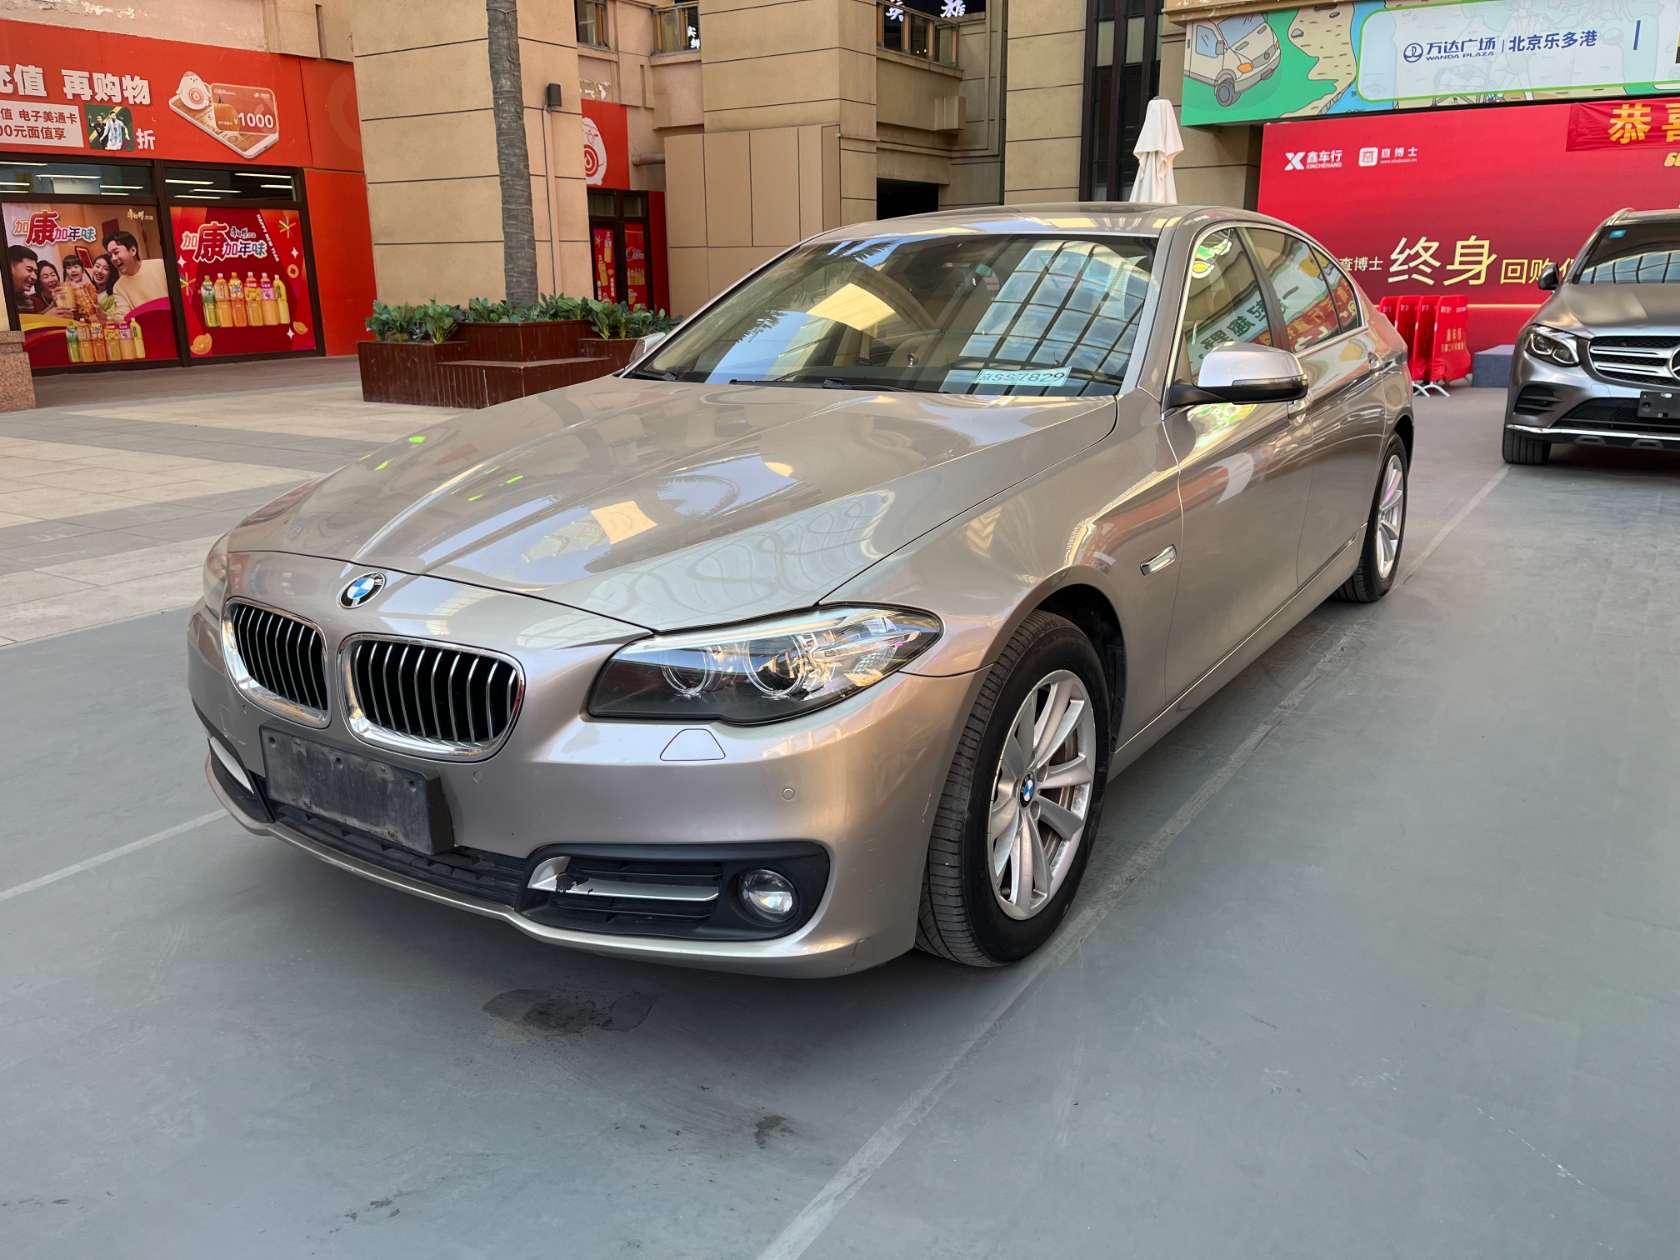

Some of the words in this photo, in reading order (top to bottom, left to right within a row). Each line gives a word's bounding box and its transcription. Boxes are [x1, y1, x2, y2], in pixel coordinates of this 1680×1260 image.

[1426, 37, 1495, 55] 万达广场
[1508, 30, 1598, 53] 北京乐多港
[61, 69, 151, 105] 再购物
[19, 109, 77, 125] 电子美通卡
[136, 128, 155, 150] 折
[1307, 149, 1343, 163] 鑫车行
[1339, 256, 1383, 272] 查博士
[1387, 235, 1497, 286] 终身
